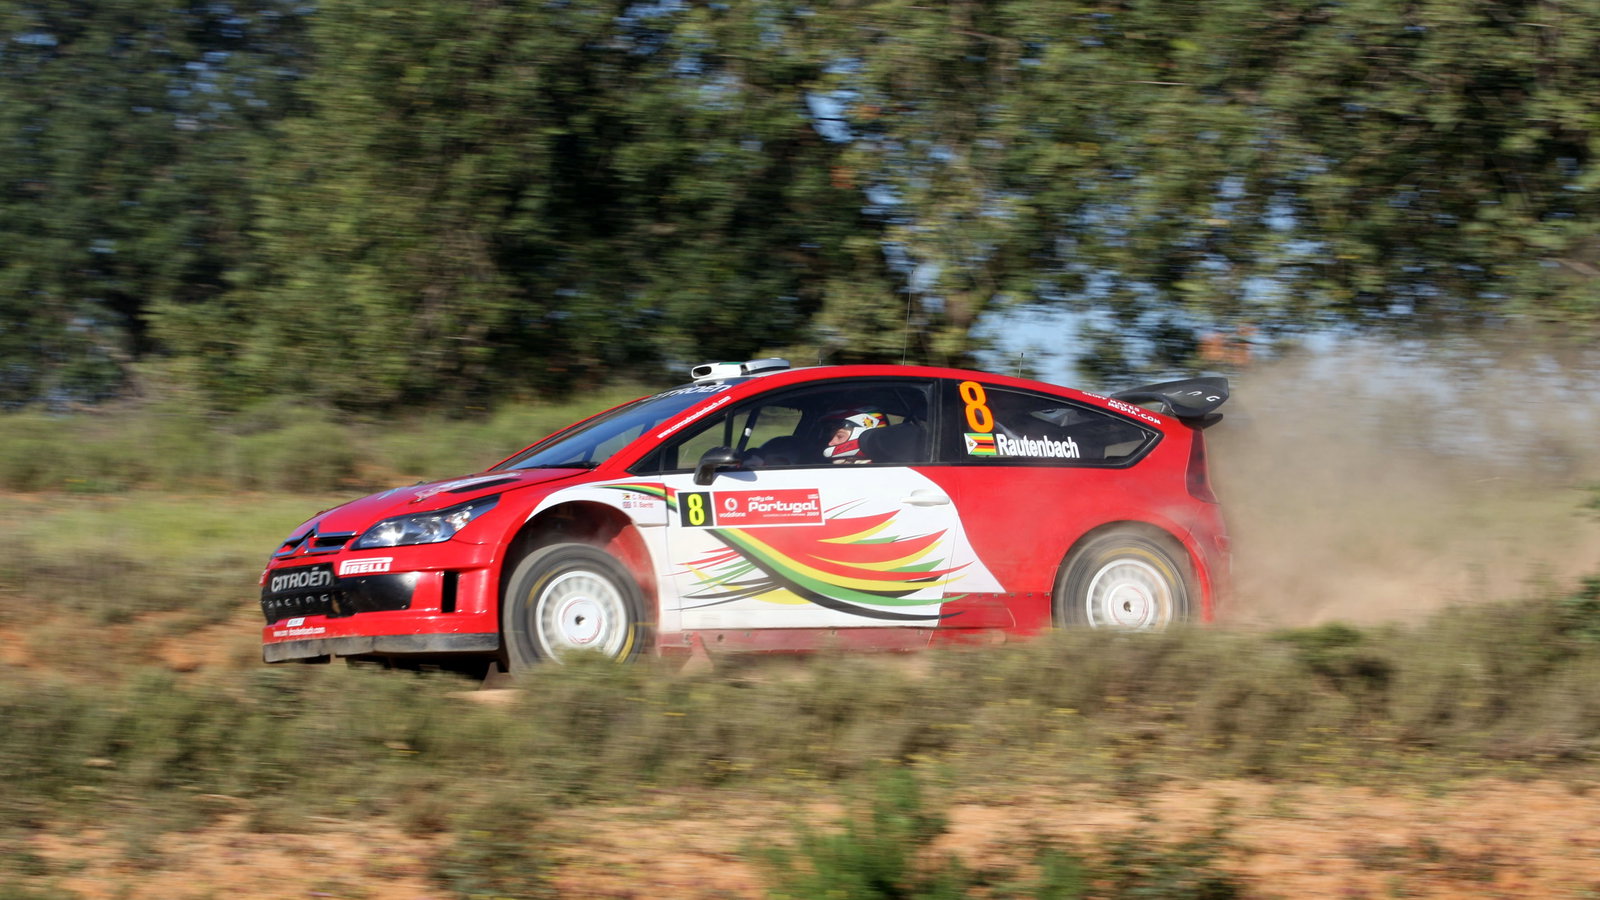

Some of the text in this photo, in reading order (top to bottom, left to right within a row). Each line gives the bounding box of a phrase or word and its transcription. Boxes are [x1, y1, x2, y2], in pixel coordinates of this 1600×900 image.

[958, 381, 995, 434] 8
[1107, 402, 1161, 425] MEDIA.COM
[996, 434, 1080, 459] Rautenbach
[687, 493, 705, 525] 8
[748, 500, 818, 513] Portugal
[339, 557, 393, 576] PIRELLI
